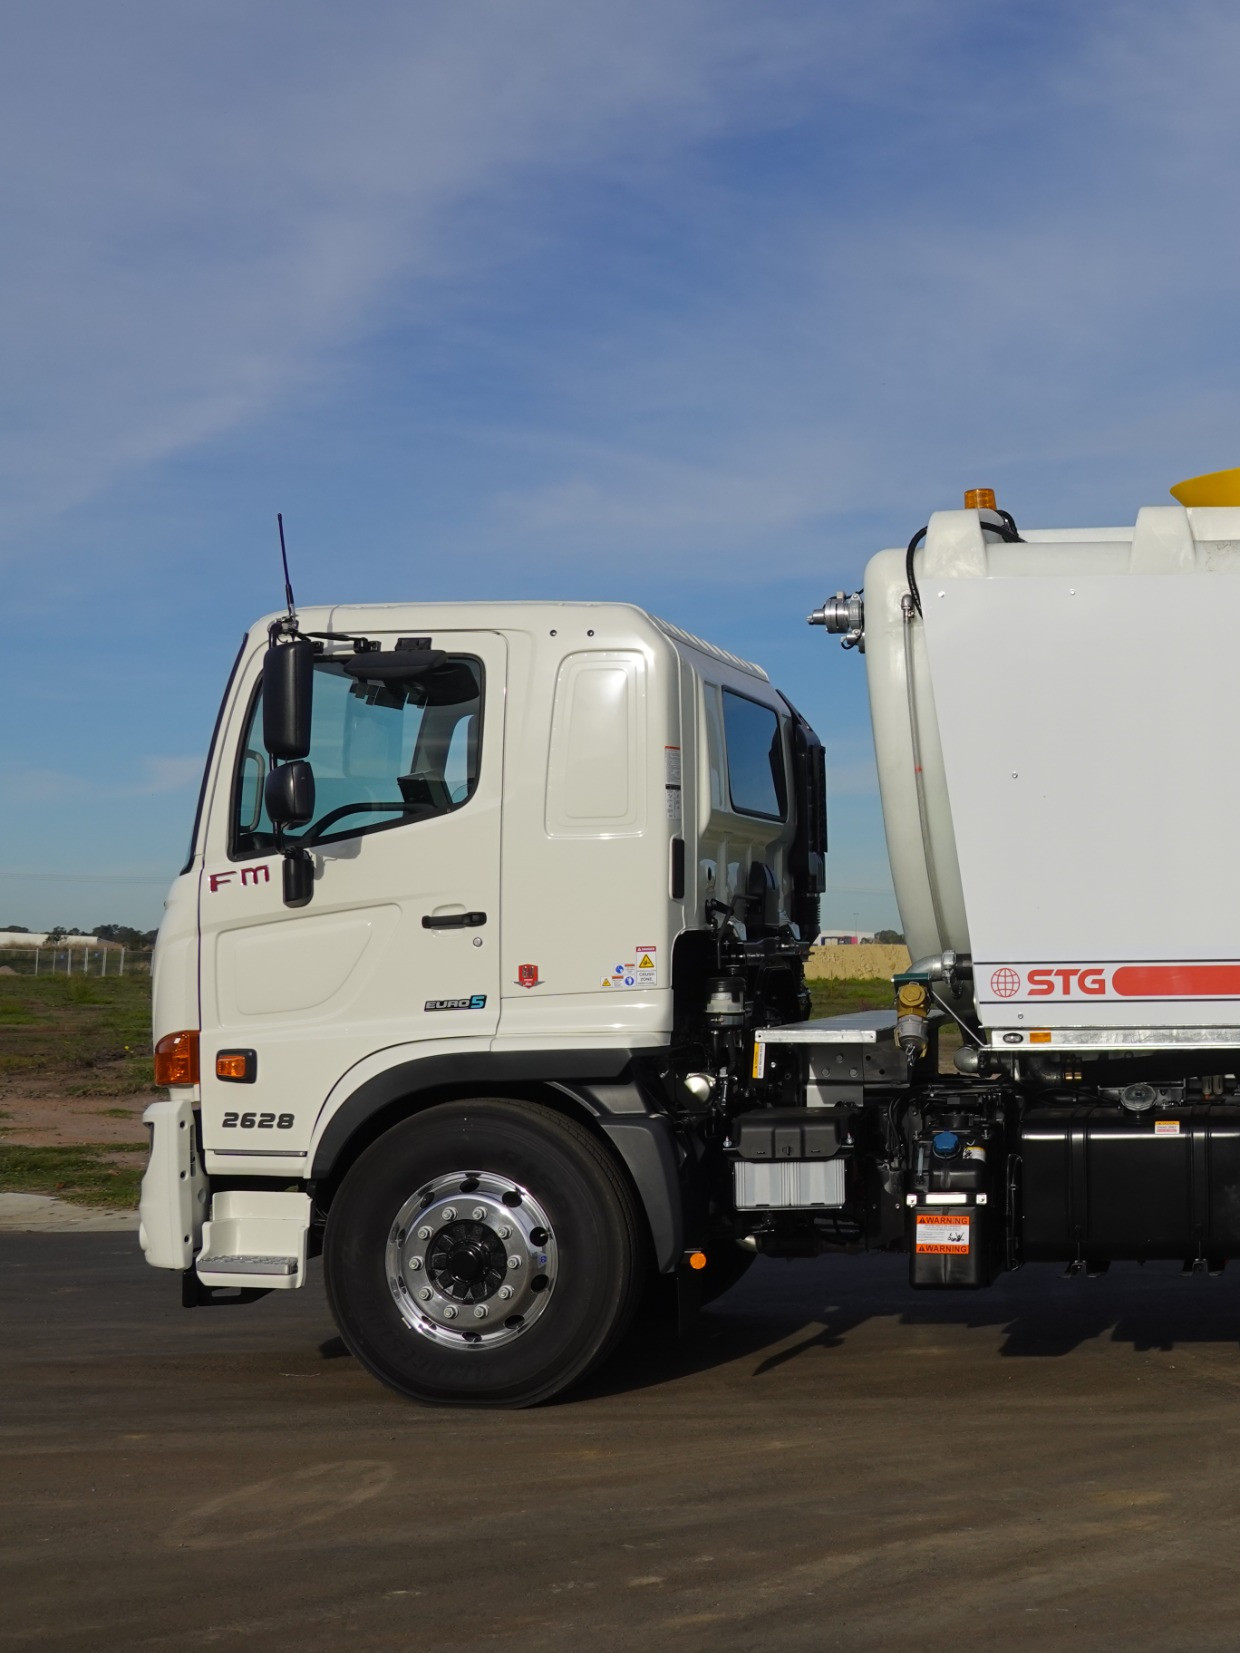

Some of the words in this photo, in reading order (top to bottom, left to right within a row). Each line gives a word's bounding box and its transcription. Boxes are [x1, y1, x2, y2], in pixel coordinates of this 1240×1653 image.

[1027, 968, 1106, 996] STG
[222, 1111, 295, 1130] 2628
[926, 1216, 968, 1224] WARNING
[926, 1245, 967, 1253] WARNING
